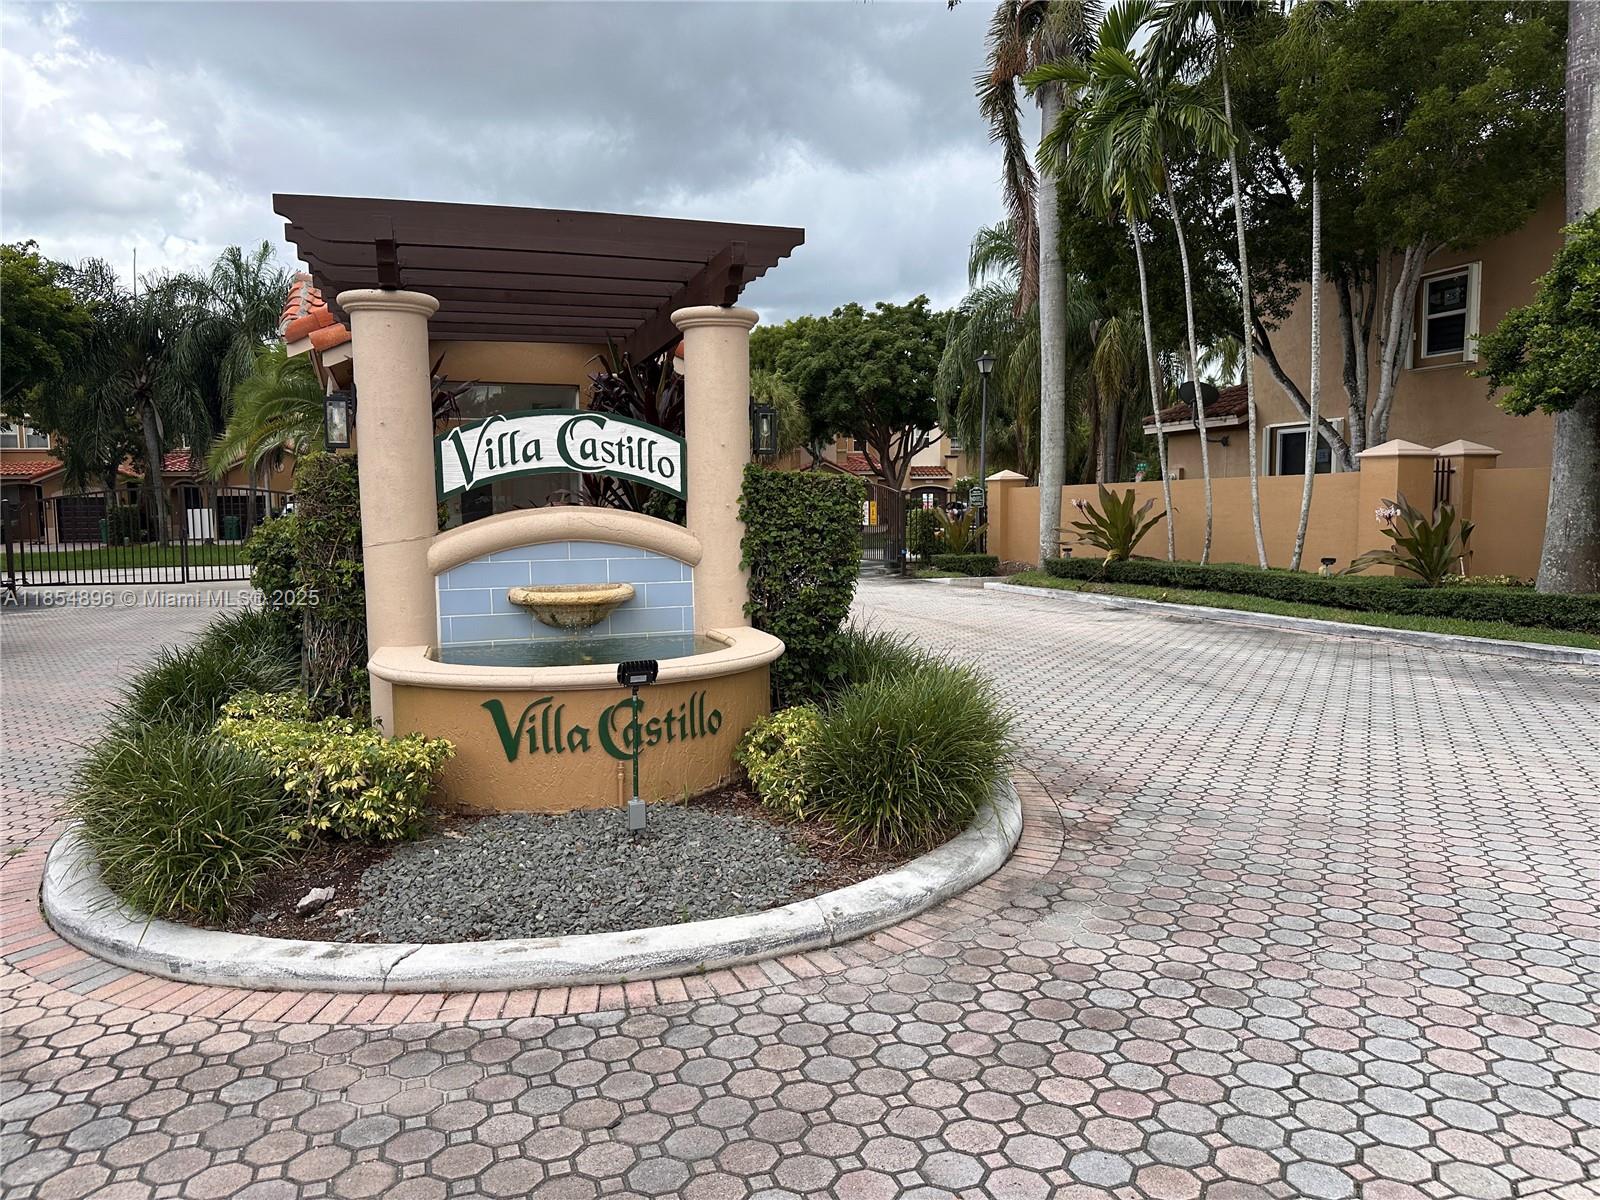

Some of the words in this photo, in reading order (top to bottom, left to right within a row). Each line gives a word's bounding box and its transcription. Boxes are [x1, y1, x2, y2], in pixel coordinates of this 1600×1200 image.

[449, 415, 544, 490] Villa
[557, 414, 675, 479] Castillo
[480, 696, 591, 763] Villa
[598, 690, 722, 761] Castillo
